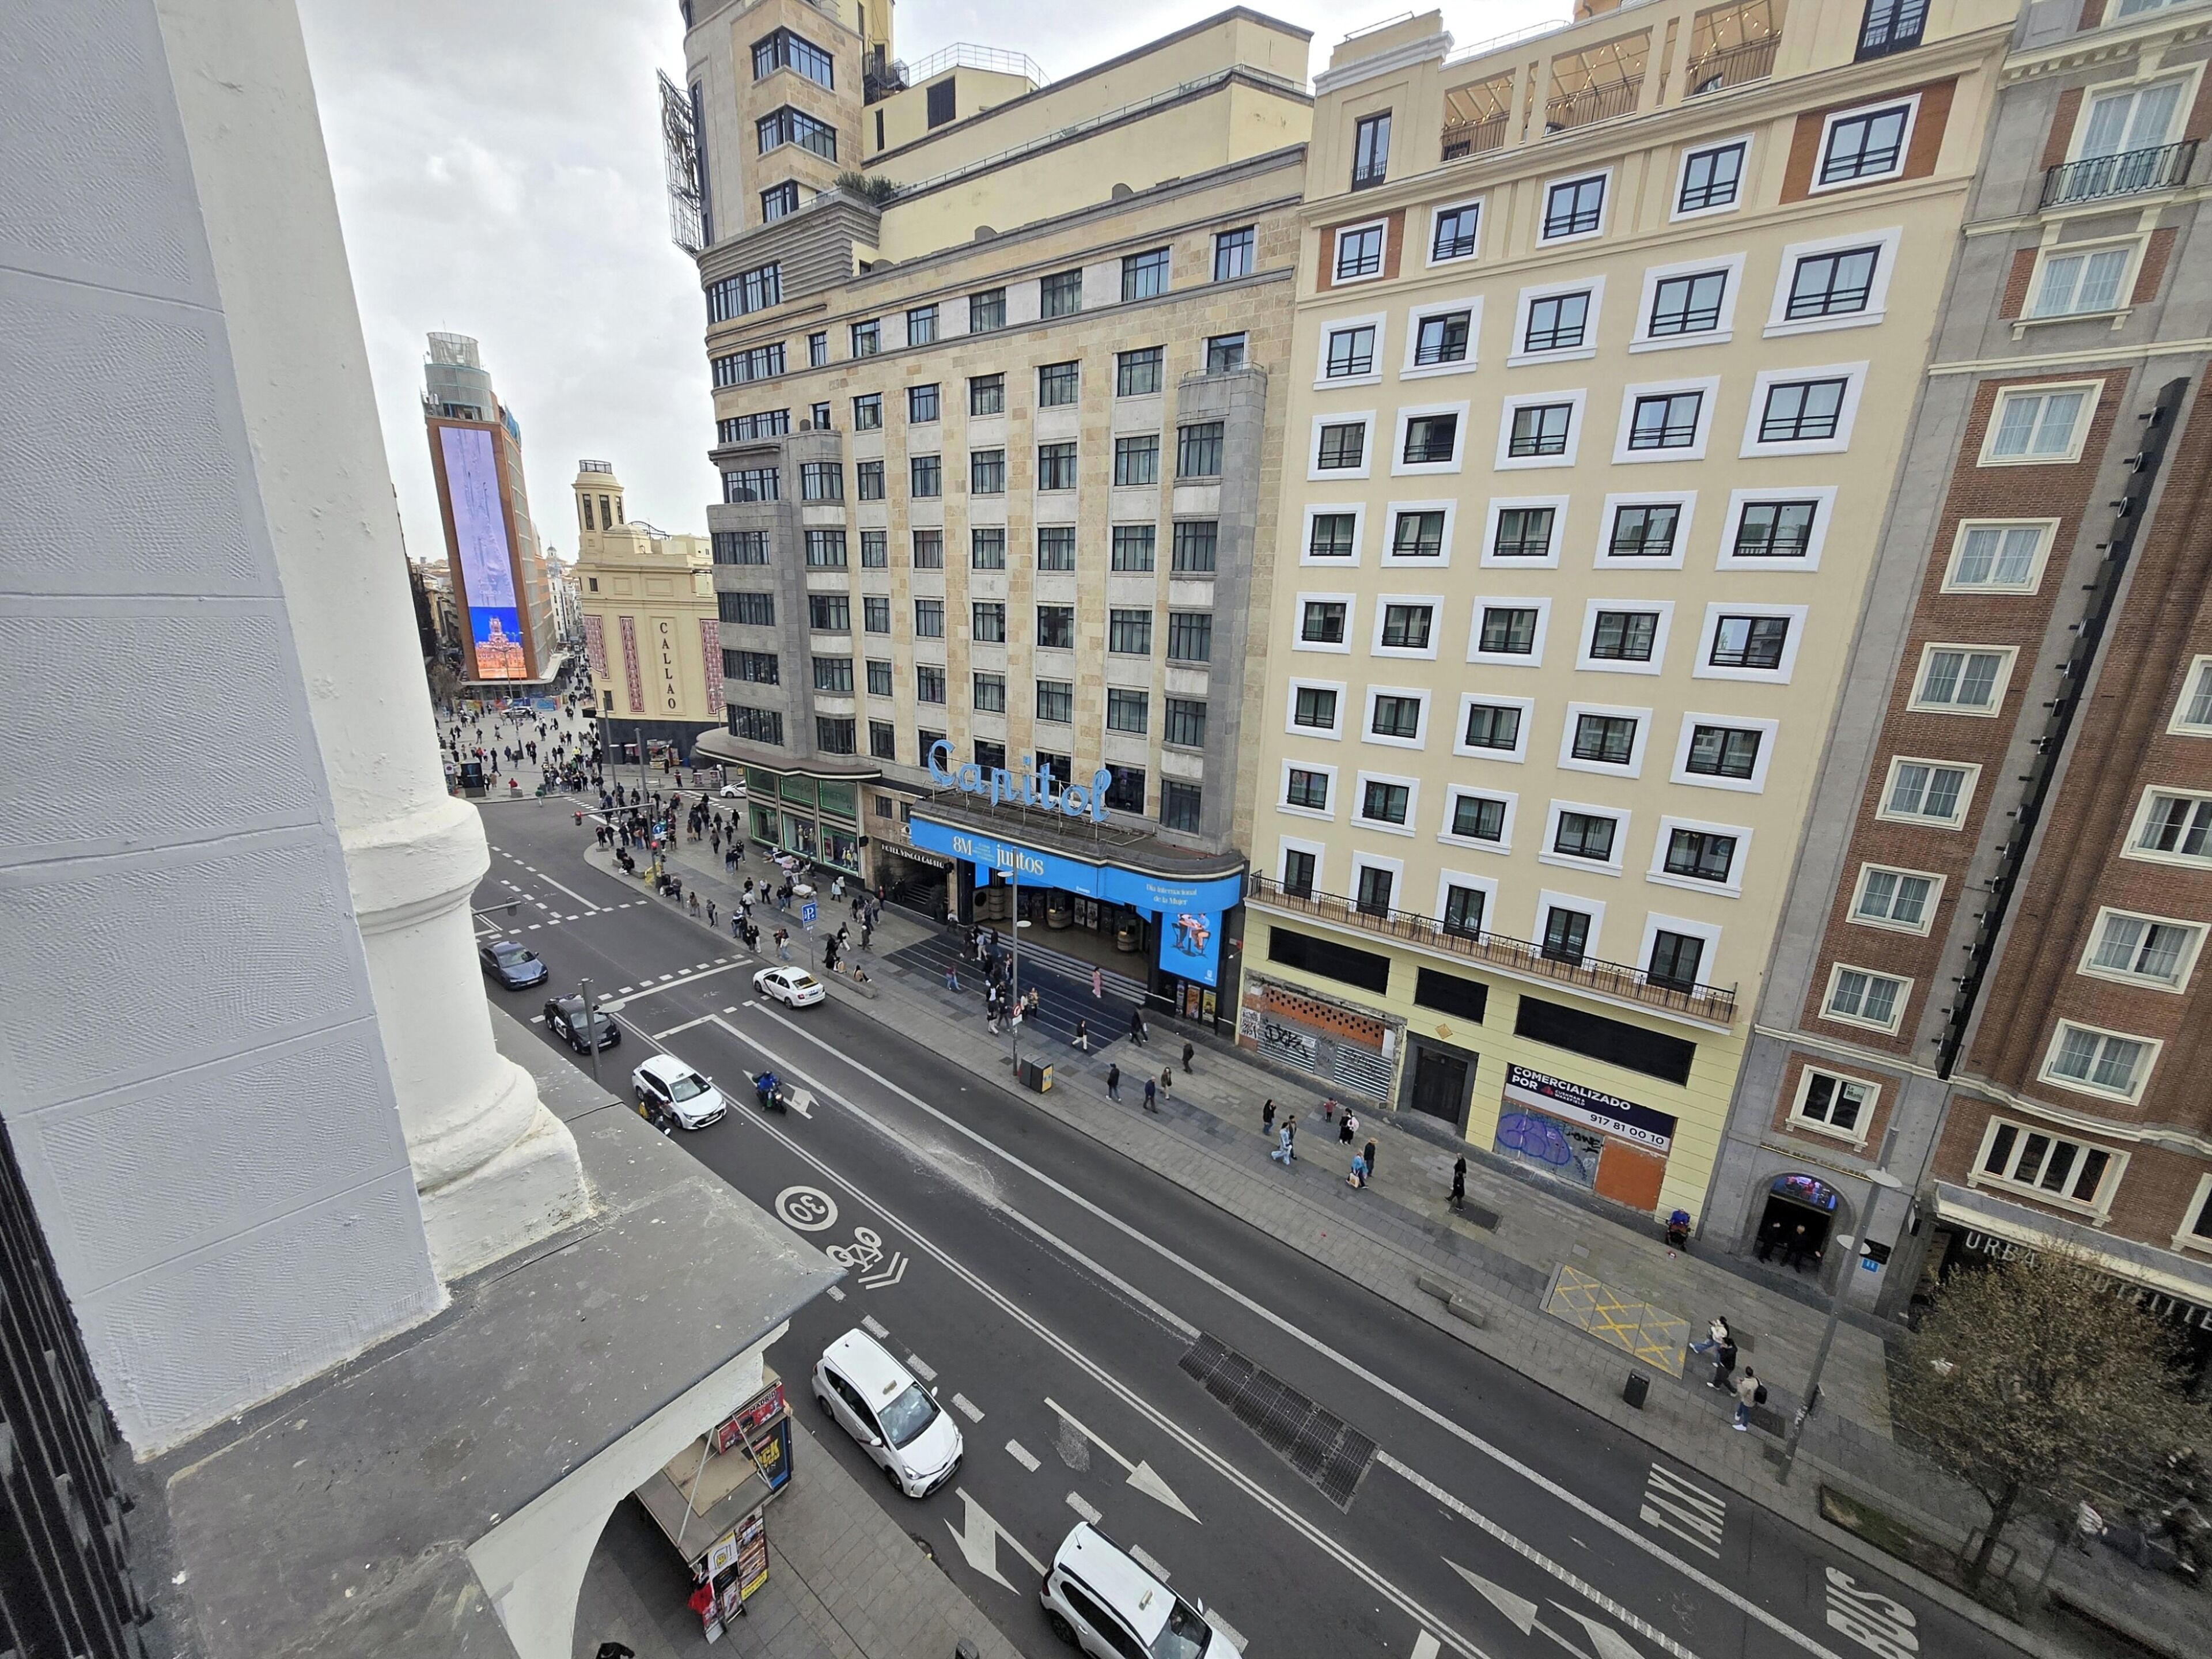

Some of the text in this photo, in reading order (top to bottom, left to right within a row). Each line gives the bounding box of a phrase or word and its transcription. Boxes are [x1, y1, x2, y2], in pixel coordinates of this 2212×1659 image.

[660, 622, 676, 709] CALLAO
[928, 739, 1112, 823] Capitol
[953, 836, 972, 856] 8M
[922, 856, 945, 869] CAPITO
[1169, 897, 1188, 906] Mujer
[1512, 1075, 1538, 1090] POR
[1514, 1066, 1631, 1110] COMERCIALIZADO
[1555, 1090, 1581, 1101] CUSHMAN
[1555, 1093, 1585, 1106] WAKEFIELD
[1590, 1114, 1610, 1126] 917
[1613, 1122, 1626, 1132] 81
[1629, 1128, 1646, 1138] 00
[1650, 1134, 1664, 1145] 10
[789, 1195, 825, 1221] 30
[1965, 1231, 2036, 1268] URBA
[749, 1390, 777, 1412] MADRID
[1639, 1462, 1726, 1559] TAXI
[1825, 1566, 1919, 1659] BUS
